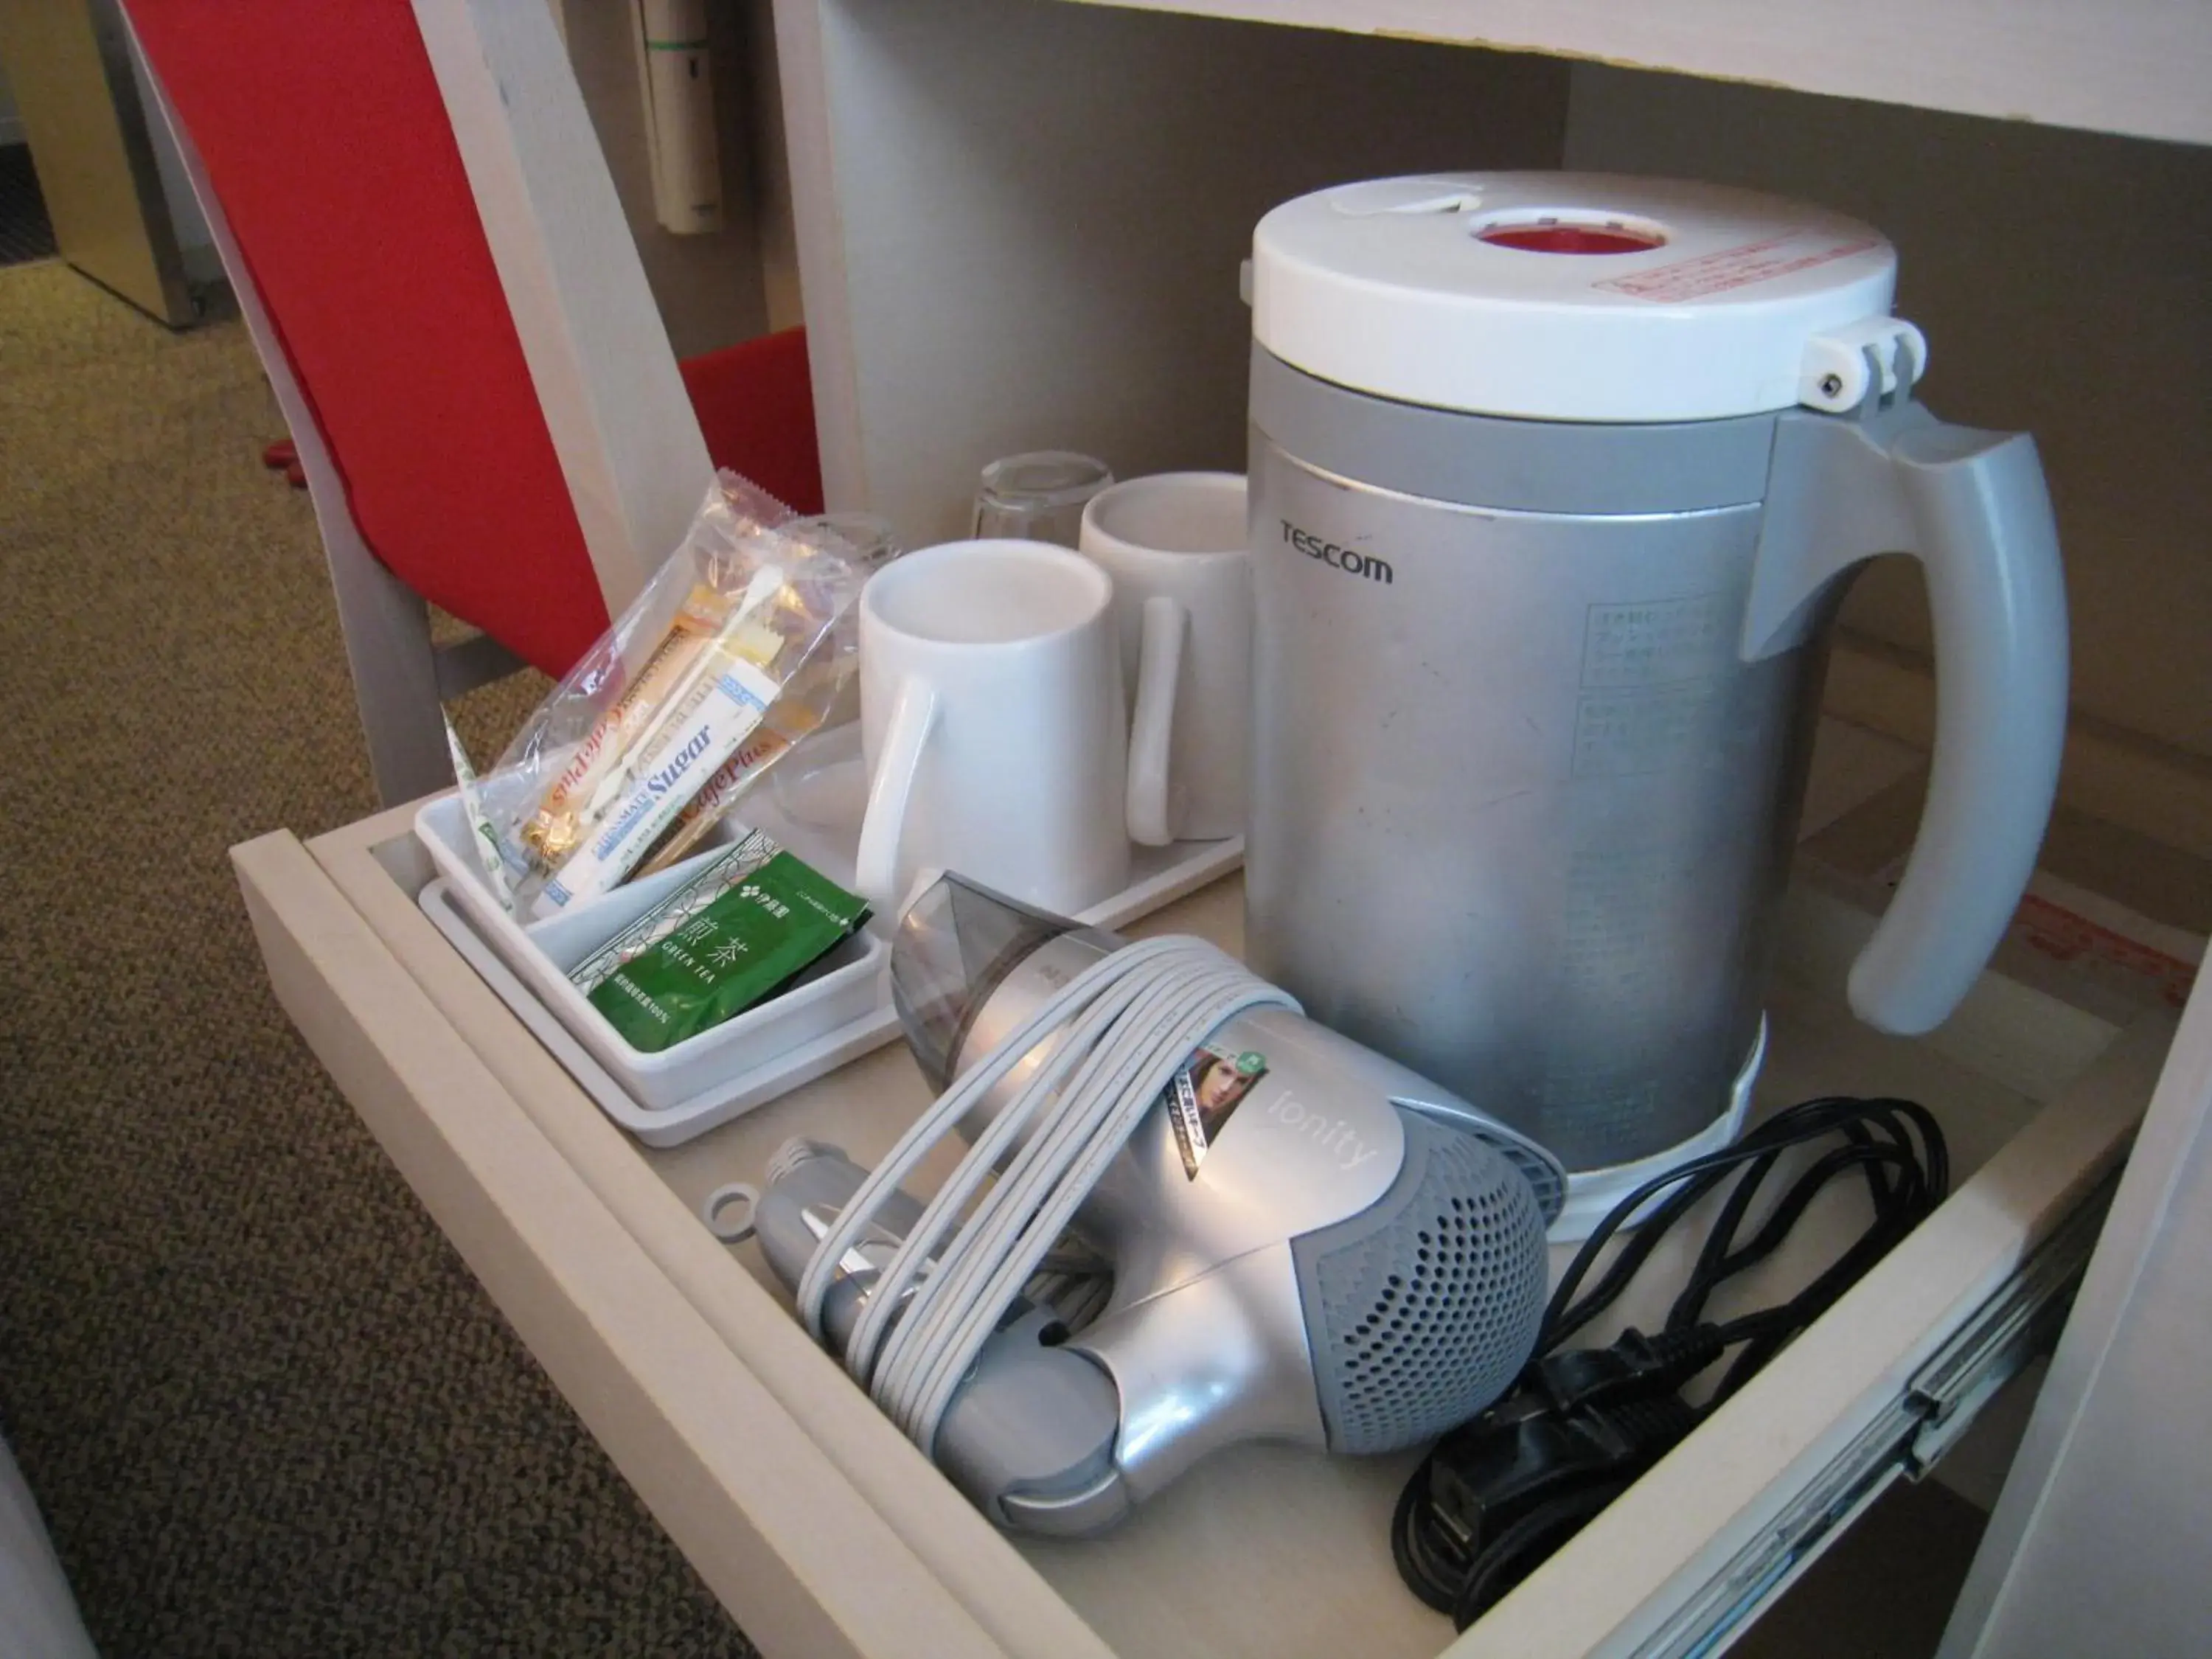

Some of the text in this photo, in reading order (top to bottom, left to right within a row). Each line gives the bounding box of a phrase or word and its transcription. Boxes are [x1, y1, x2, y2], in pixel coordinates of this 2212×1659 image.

[1281, 519, 1394, 582] TESCOM
[647, 724, 713, 802] Sugar
[661, 942, 717, 986] GREEN TEA
[1267, 1090, 1378, 1171] Ionity
